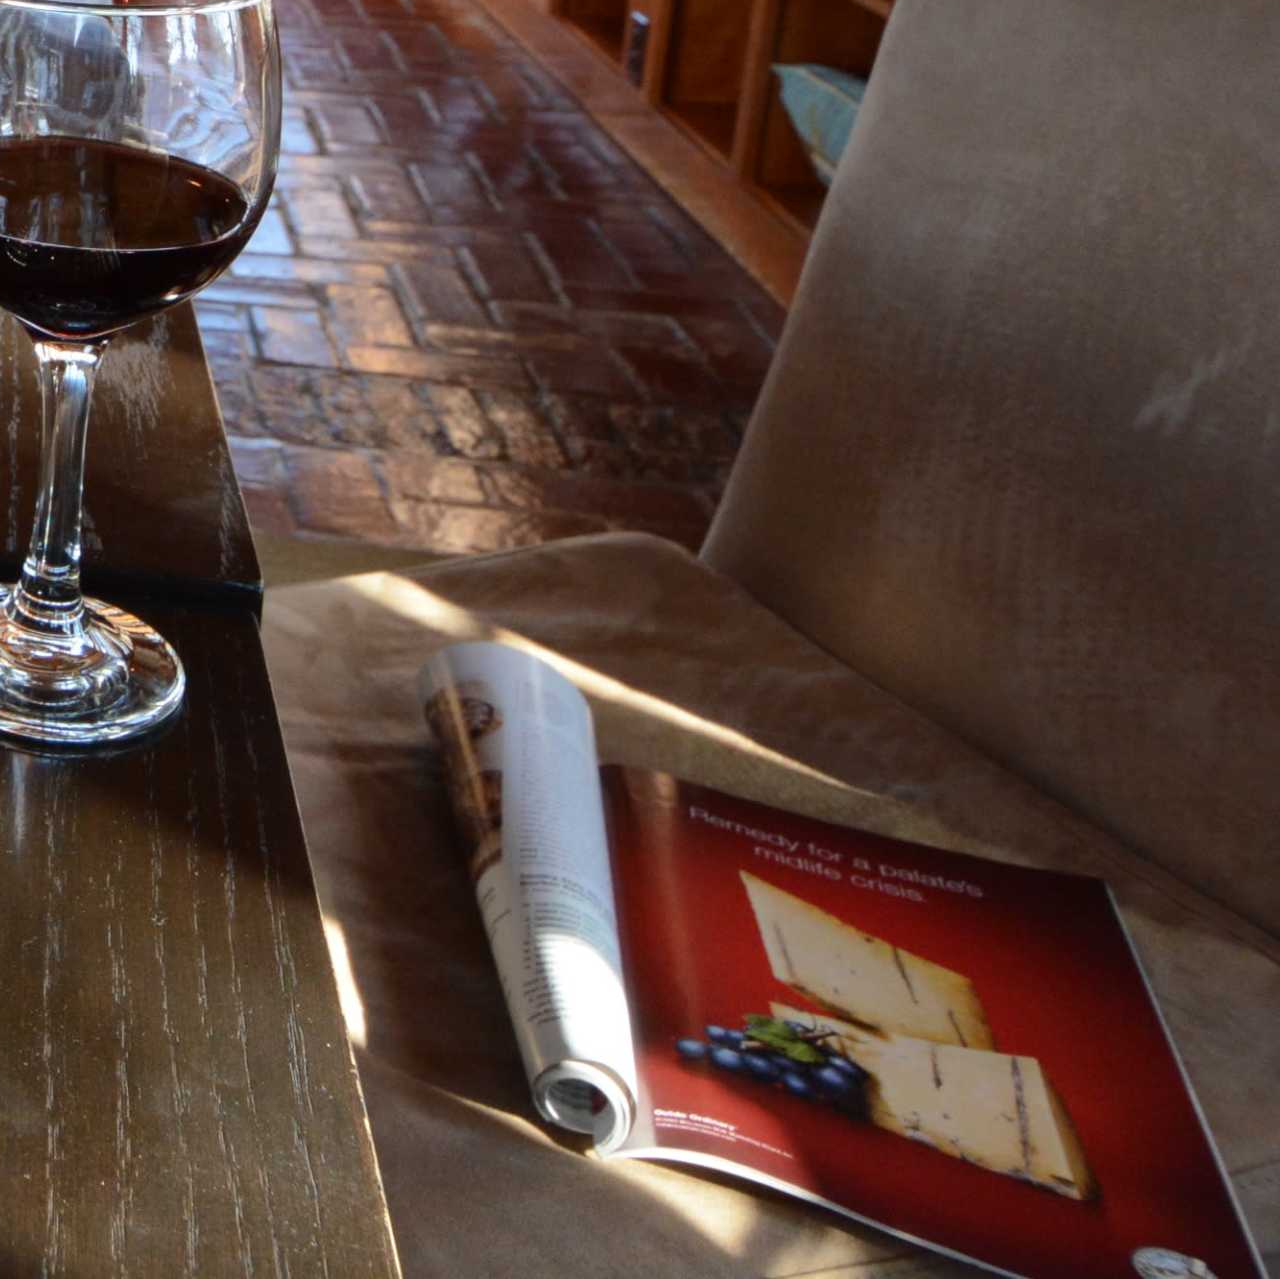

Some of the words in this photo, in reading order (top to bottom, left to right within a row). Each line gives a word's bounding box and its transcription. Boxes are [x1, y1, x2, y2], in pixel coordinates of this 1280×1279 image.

[690, 805, 799, 852] Remedy
[808, 842, 844, 862] for
[853, 857, 869, 870] a
[879, 863, 985, 898] palate's
[754, 845, 841, 880] midlife
